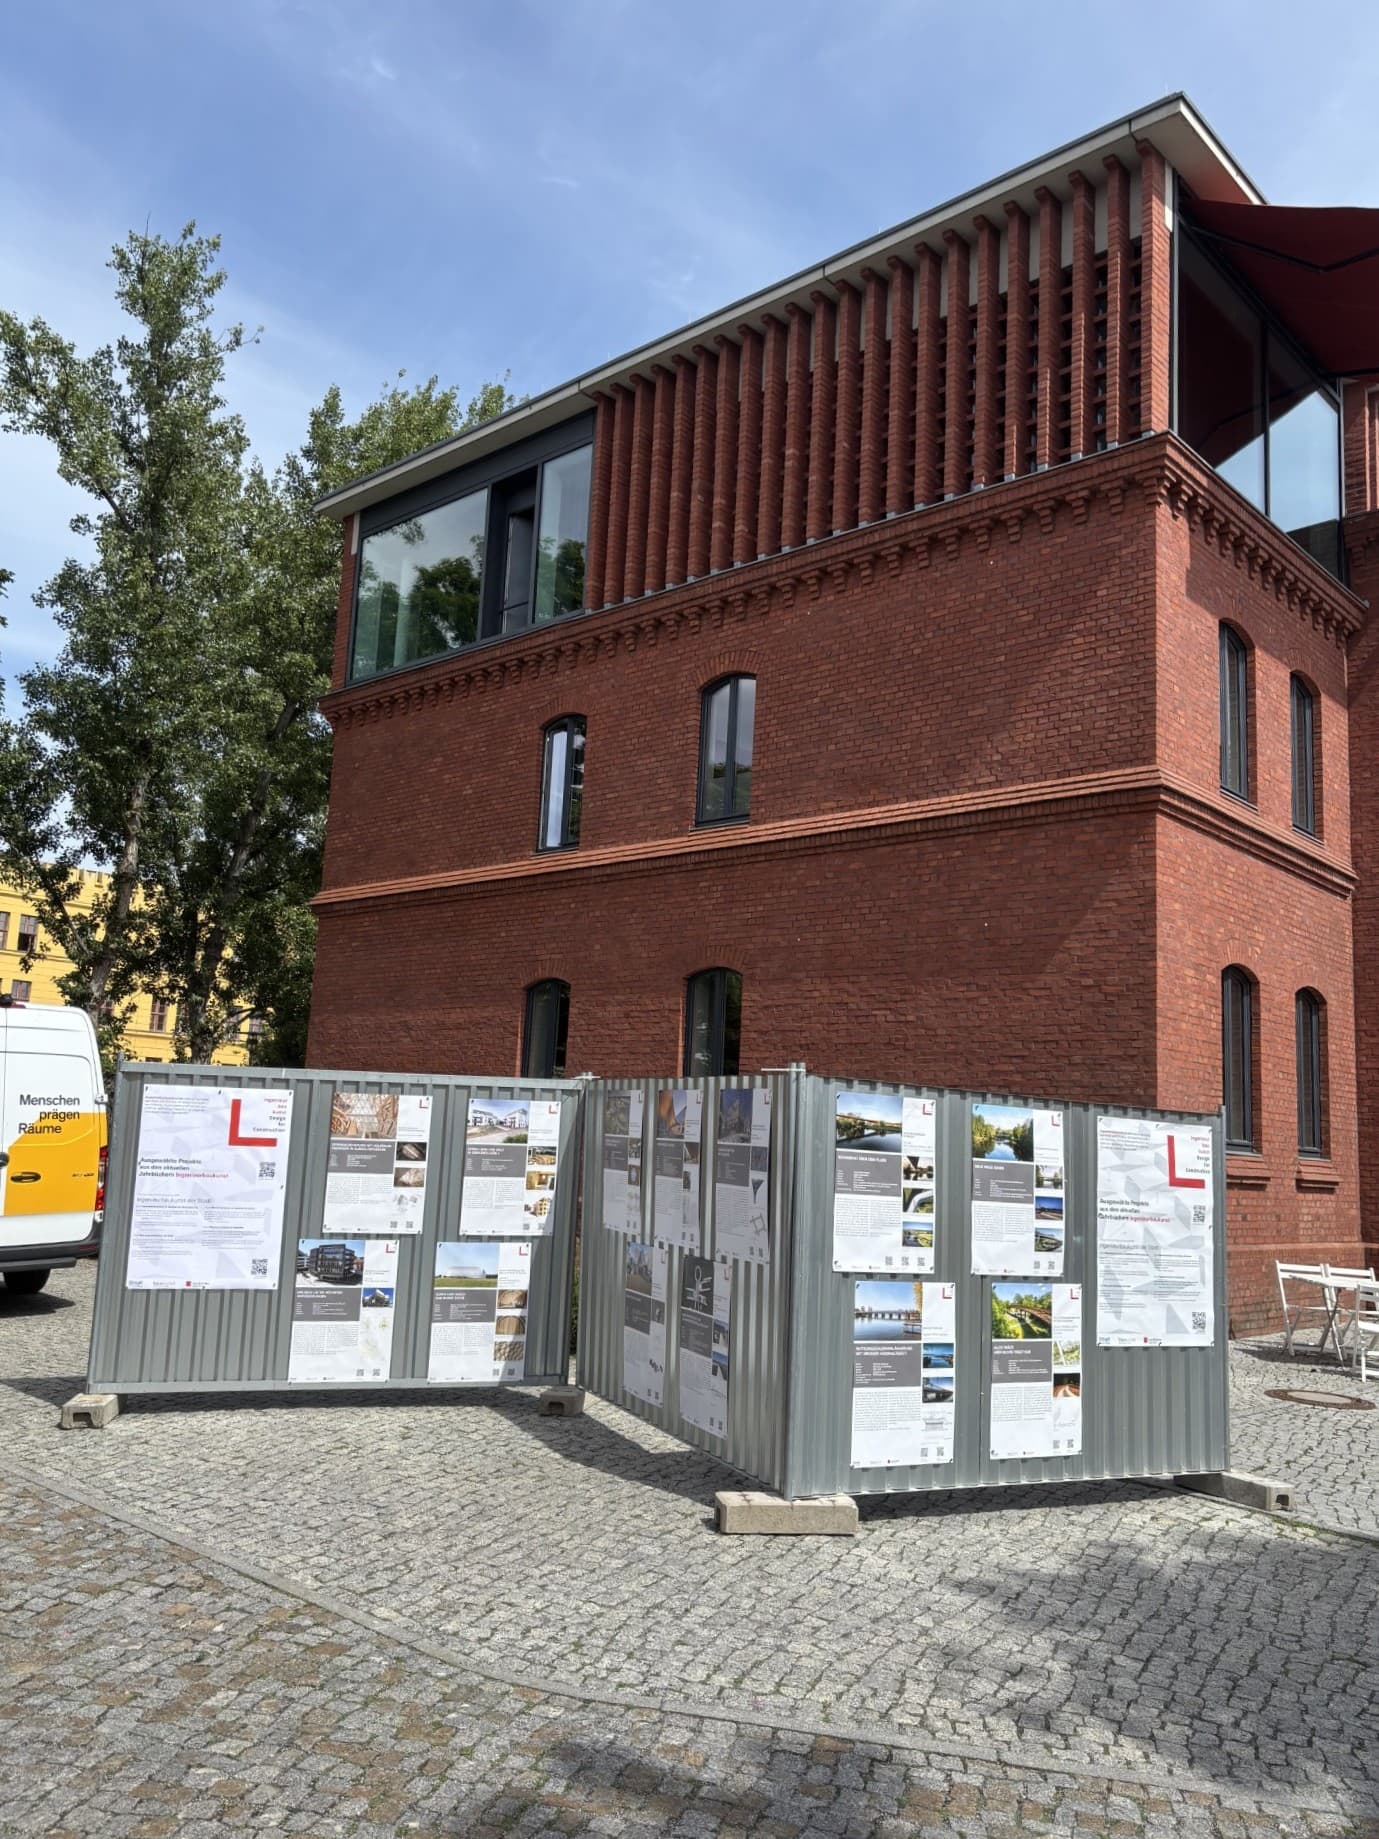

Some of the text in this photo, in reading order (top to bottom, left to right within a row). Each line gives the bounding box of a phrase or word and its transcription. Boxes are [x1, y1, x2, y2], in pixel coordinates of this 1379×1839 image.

[19, 1094, 80, 1106] Menschen
[39, 1108, 80, 1122] prägen
[18, 1122, 62, 1134] Räume
